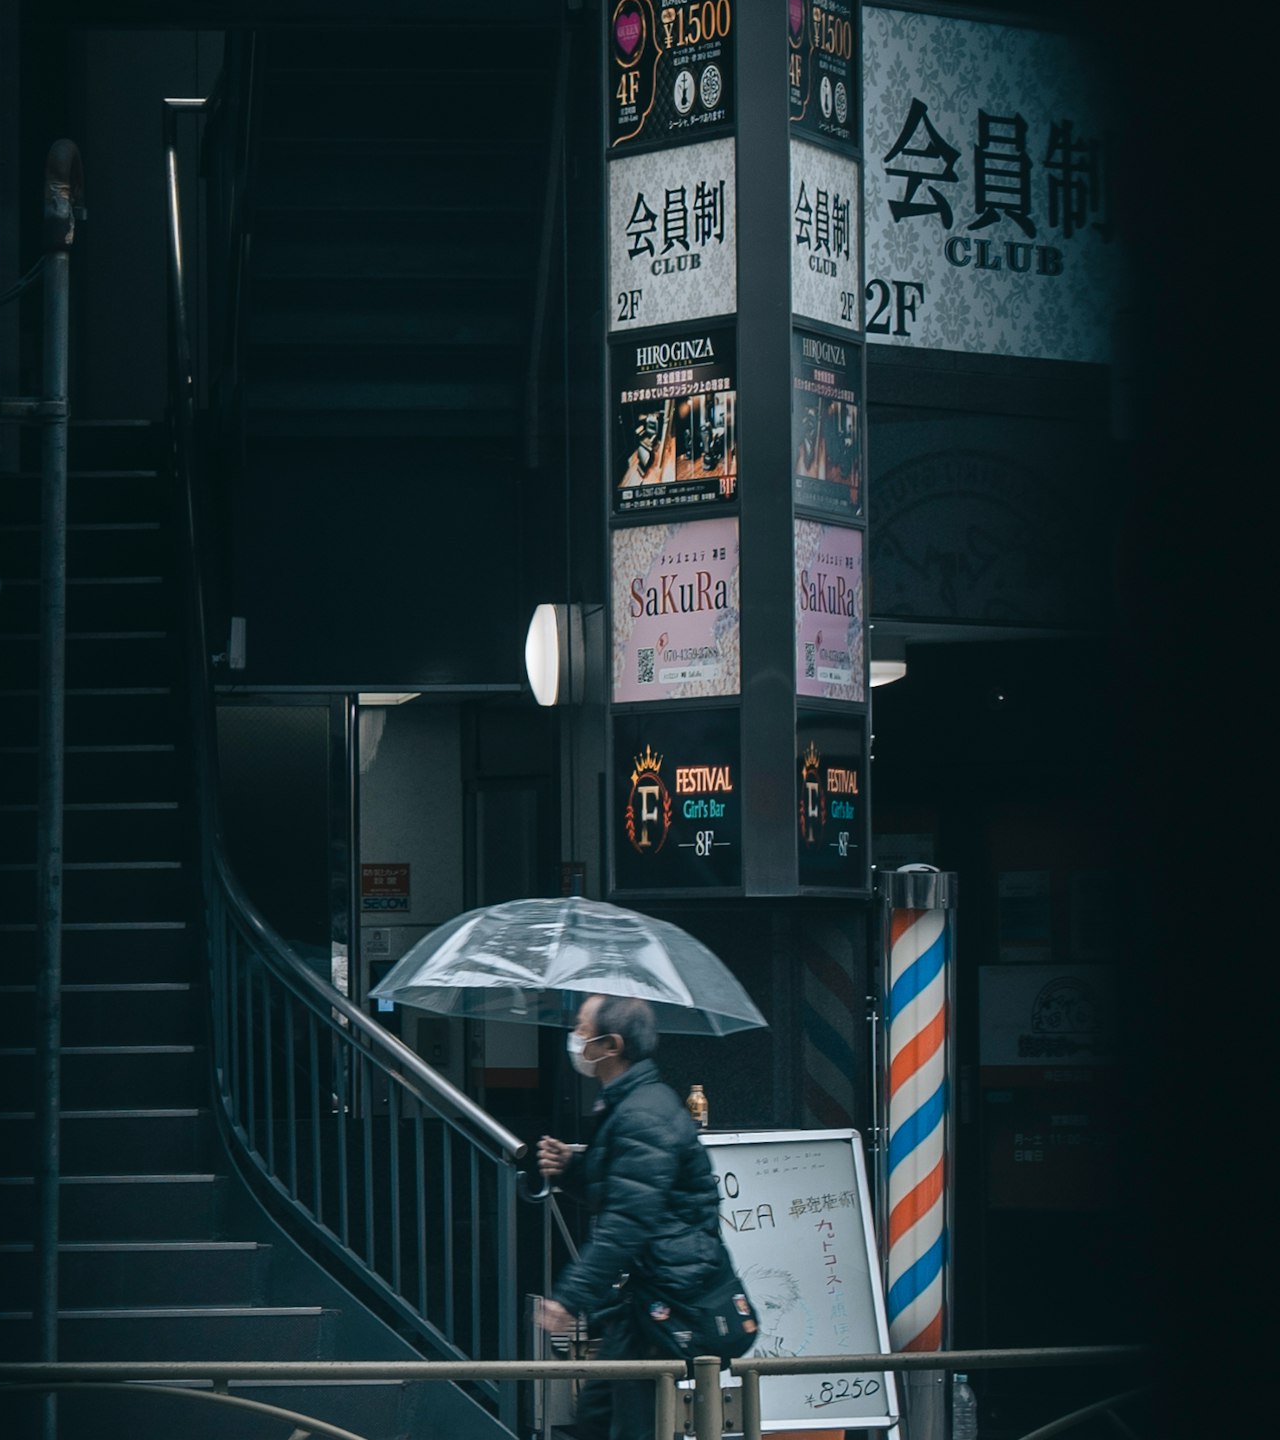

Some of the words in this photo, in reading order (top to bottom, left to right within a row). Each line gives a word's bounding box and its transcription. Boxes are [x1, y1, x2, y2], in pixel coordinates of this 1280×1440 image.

[615, 70, 641, 107] 4F
[883, 96, 1113, 245] 会員制
[625, 179, 726, 260] 会員制
[794, 180, 850, 262] 会員制
[651, 253, 702, 277] CLUB
[808, 254, 838, 278] CLUB
[944, 235, 1065, 277] CLUB
[616, 289, 643, 322] 2F
[839, 290, 855, 323] 2F
[864, 277, 925, 337] 2F
[630, 569, 729, 619] SaKuRa
[800, 569, 856, 618] SaKuRa
[675, 766, 734, 794] FESTIVAL
[826, 767, 860, 795] FESTIVAL
[683, 798, 708, 820] Girl's
[709, 799, 726, 819] Bar
[694, 830, 715, 857] 8F
[838, 830, 850, 857] 8F
[363, 898, 408, 909] SECOM
